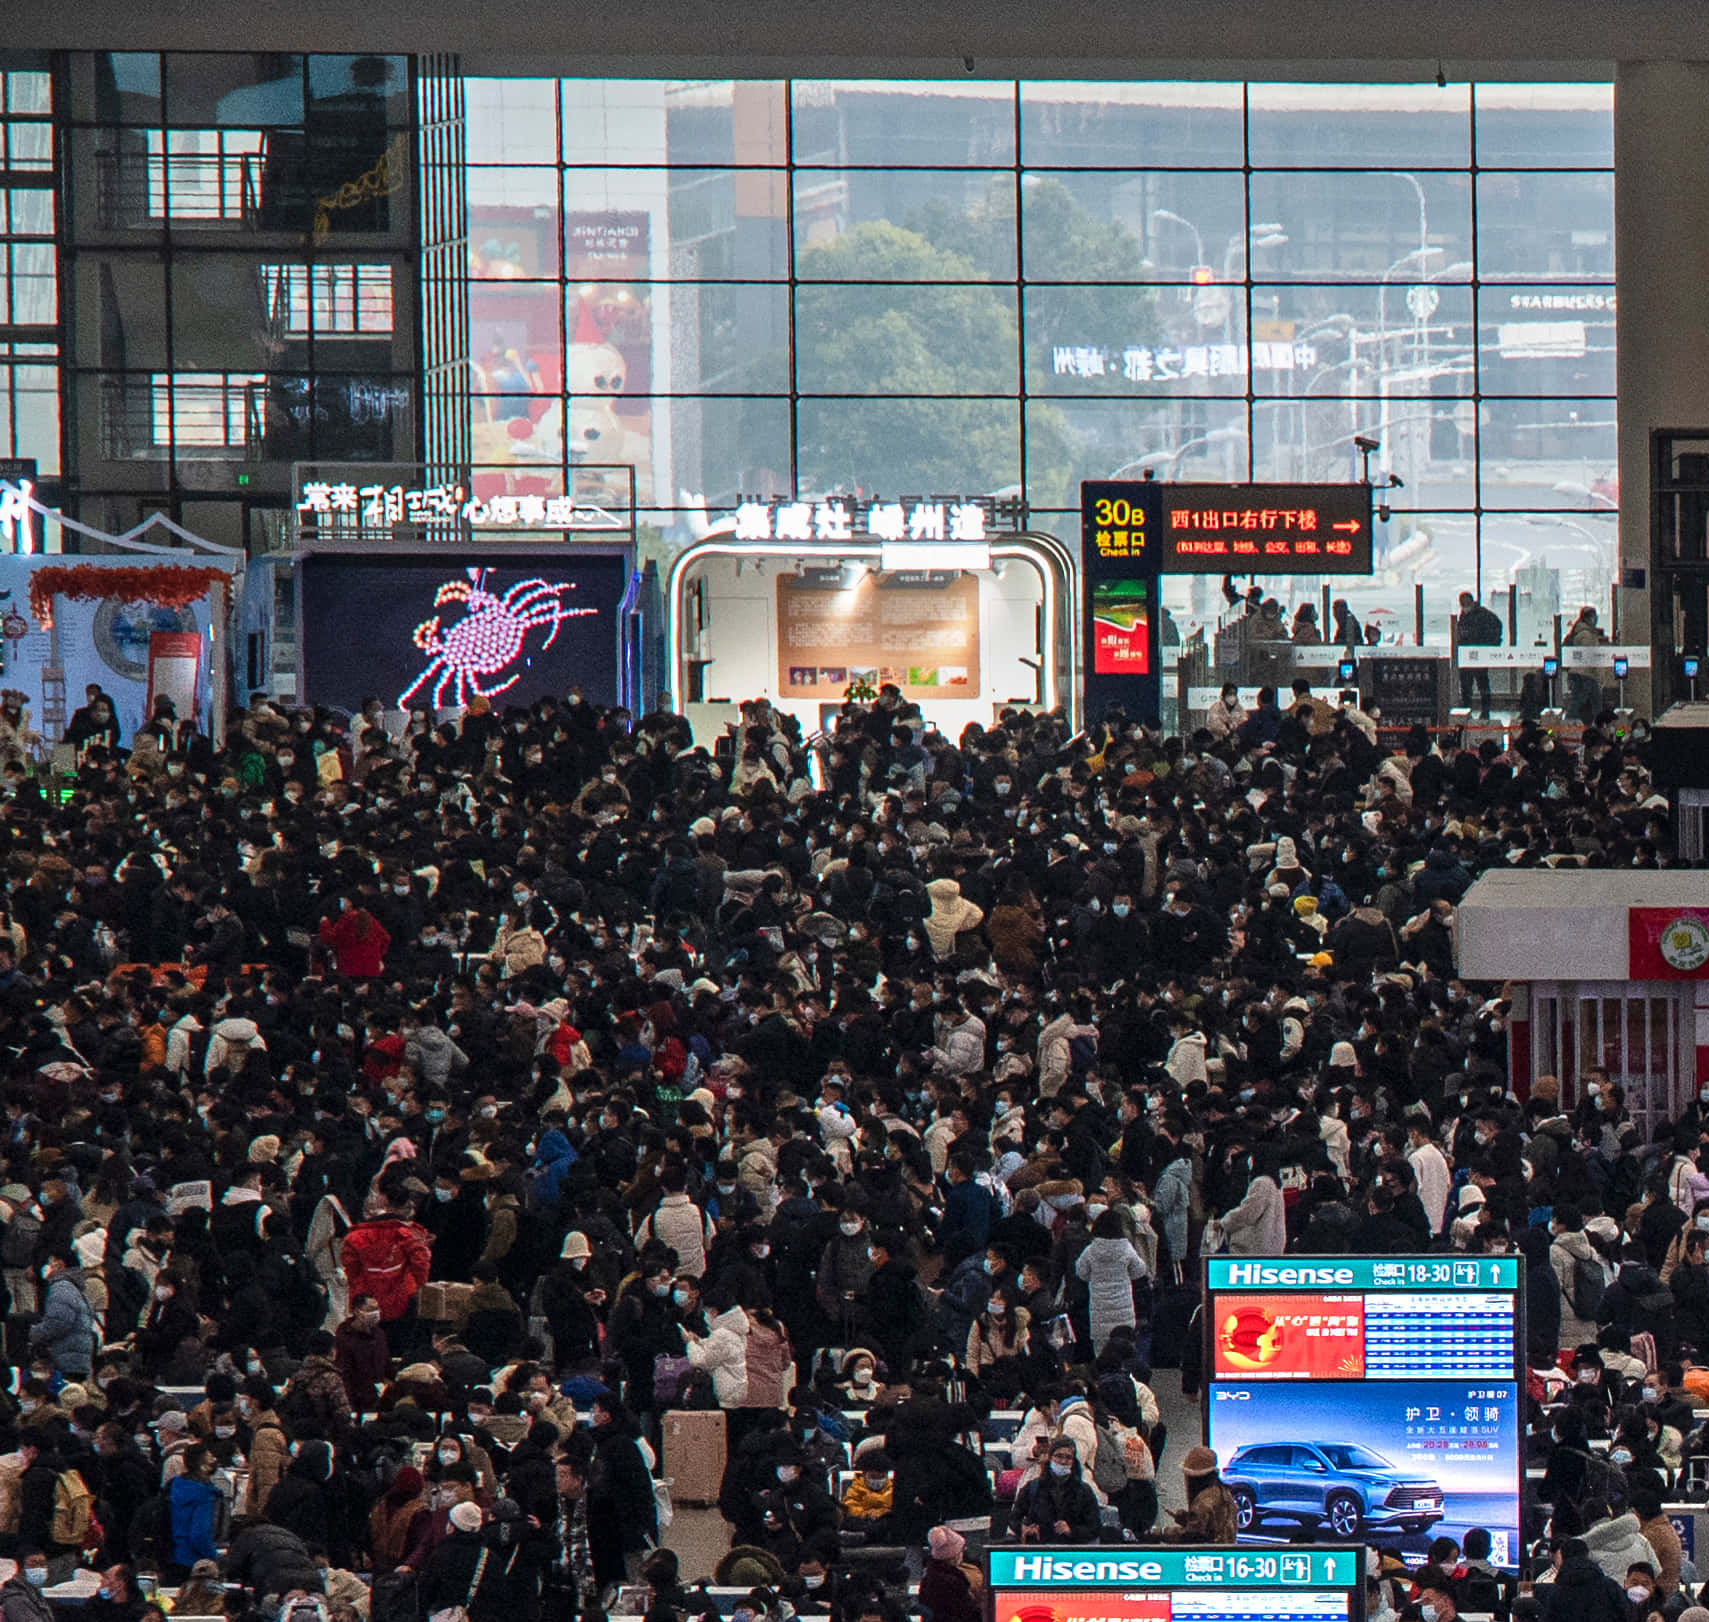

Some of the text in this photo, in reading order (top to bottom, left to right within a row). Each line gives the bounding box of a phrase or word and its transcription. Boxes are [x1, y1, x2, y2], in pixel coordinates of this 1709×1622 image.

[1095, 499, 1146, 526] 30B
[1171, 509, 1318, 530] 西1出口右行下楼
[1095, 531, 1146, 547] 检票口
[1100, 547, 1141, 557] Check in
[1229, 1263, 1354, 1285] Hisense
[1408, 1264, 1450, 1282] 18-30
[1013, 1556, 1162, 1580] Hisense
[1227, 1557, 1277, 1578] 16-30
[1185, 1573, 1223, 1582] Check in
